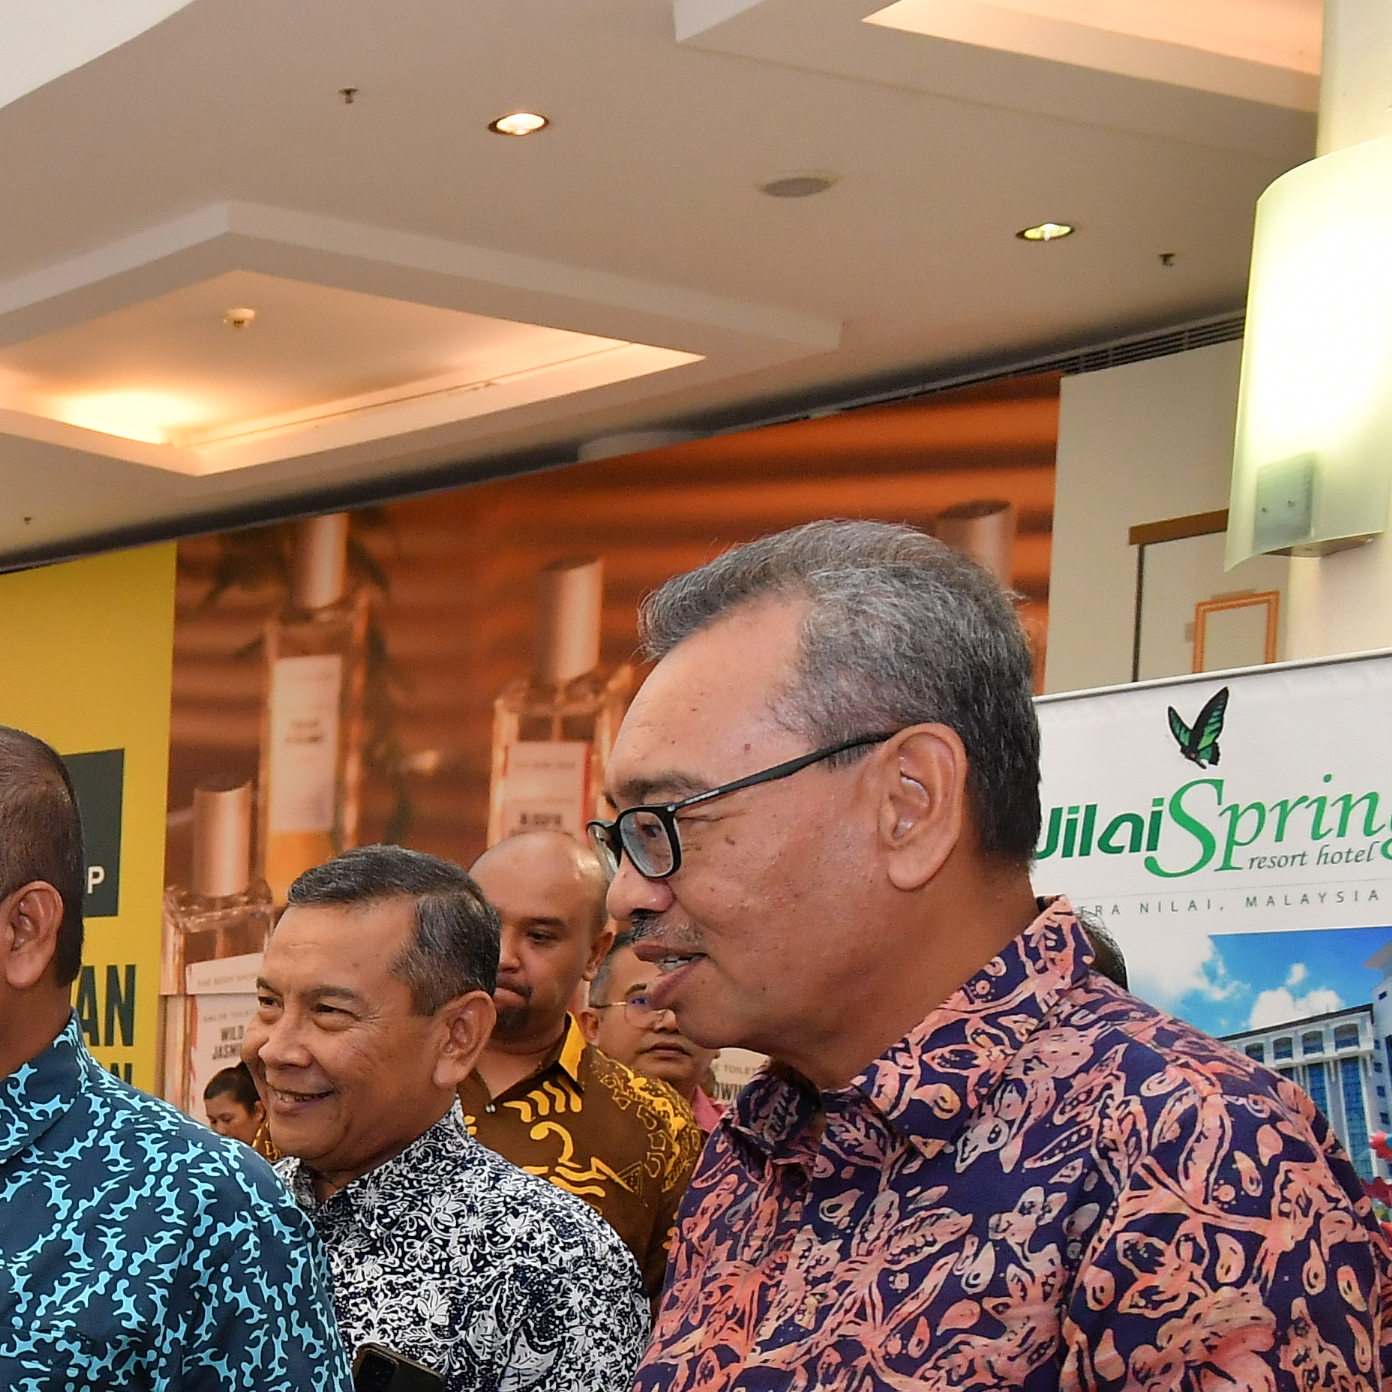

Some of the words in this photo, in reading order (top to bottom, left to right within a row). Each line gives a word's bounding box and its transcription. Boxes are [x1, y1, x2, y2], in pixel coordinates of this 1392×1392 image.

[1246, 849, 1309, 871] resort
[1315, 842, 1377, 866] hotel
[1245, 888, 1381, 909] MALAYSIA
